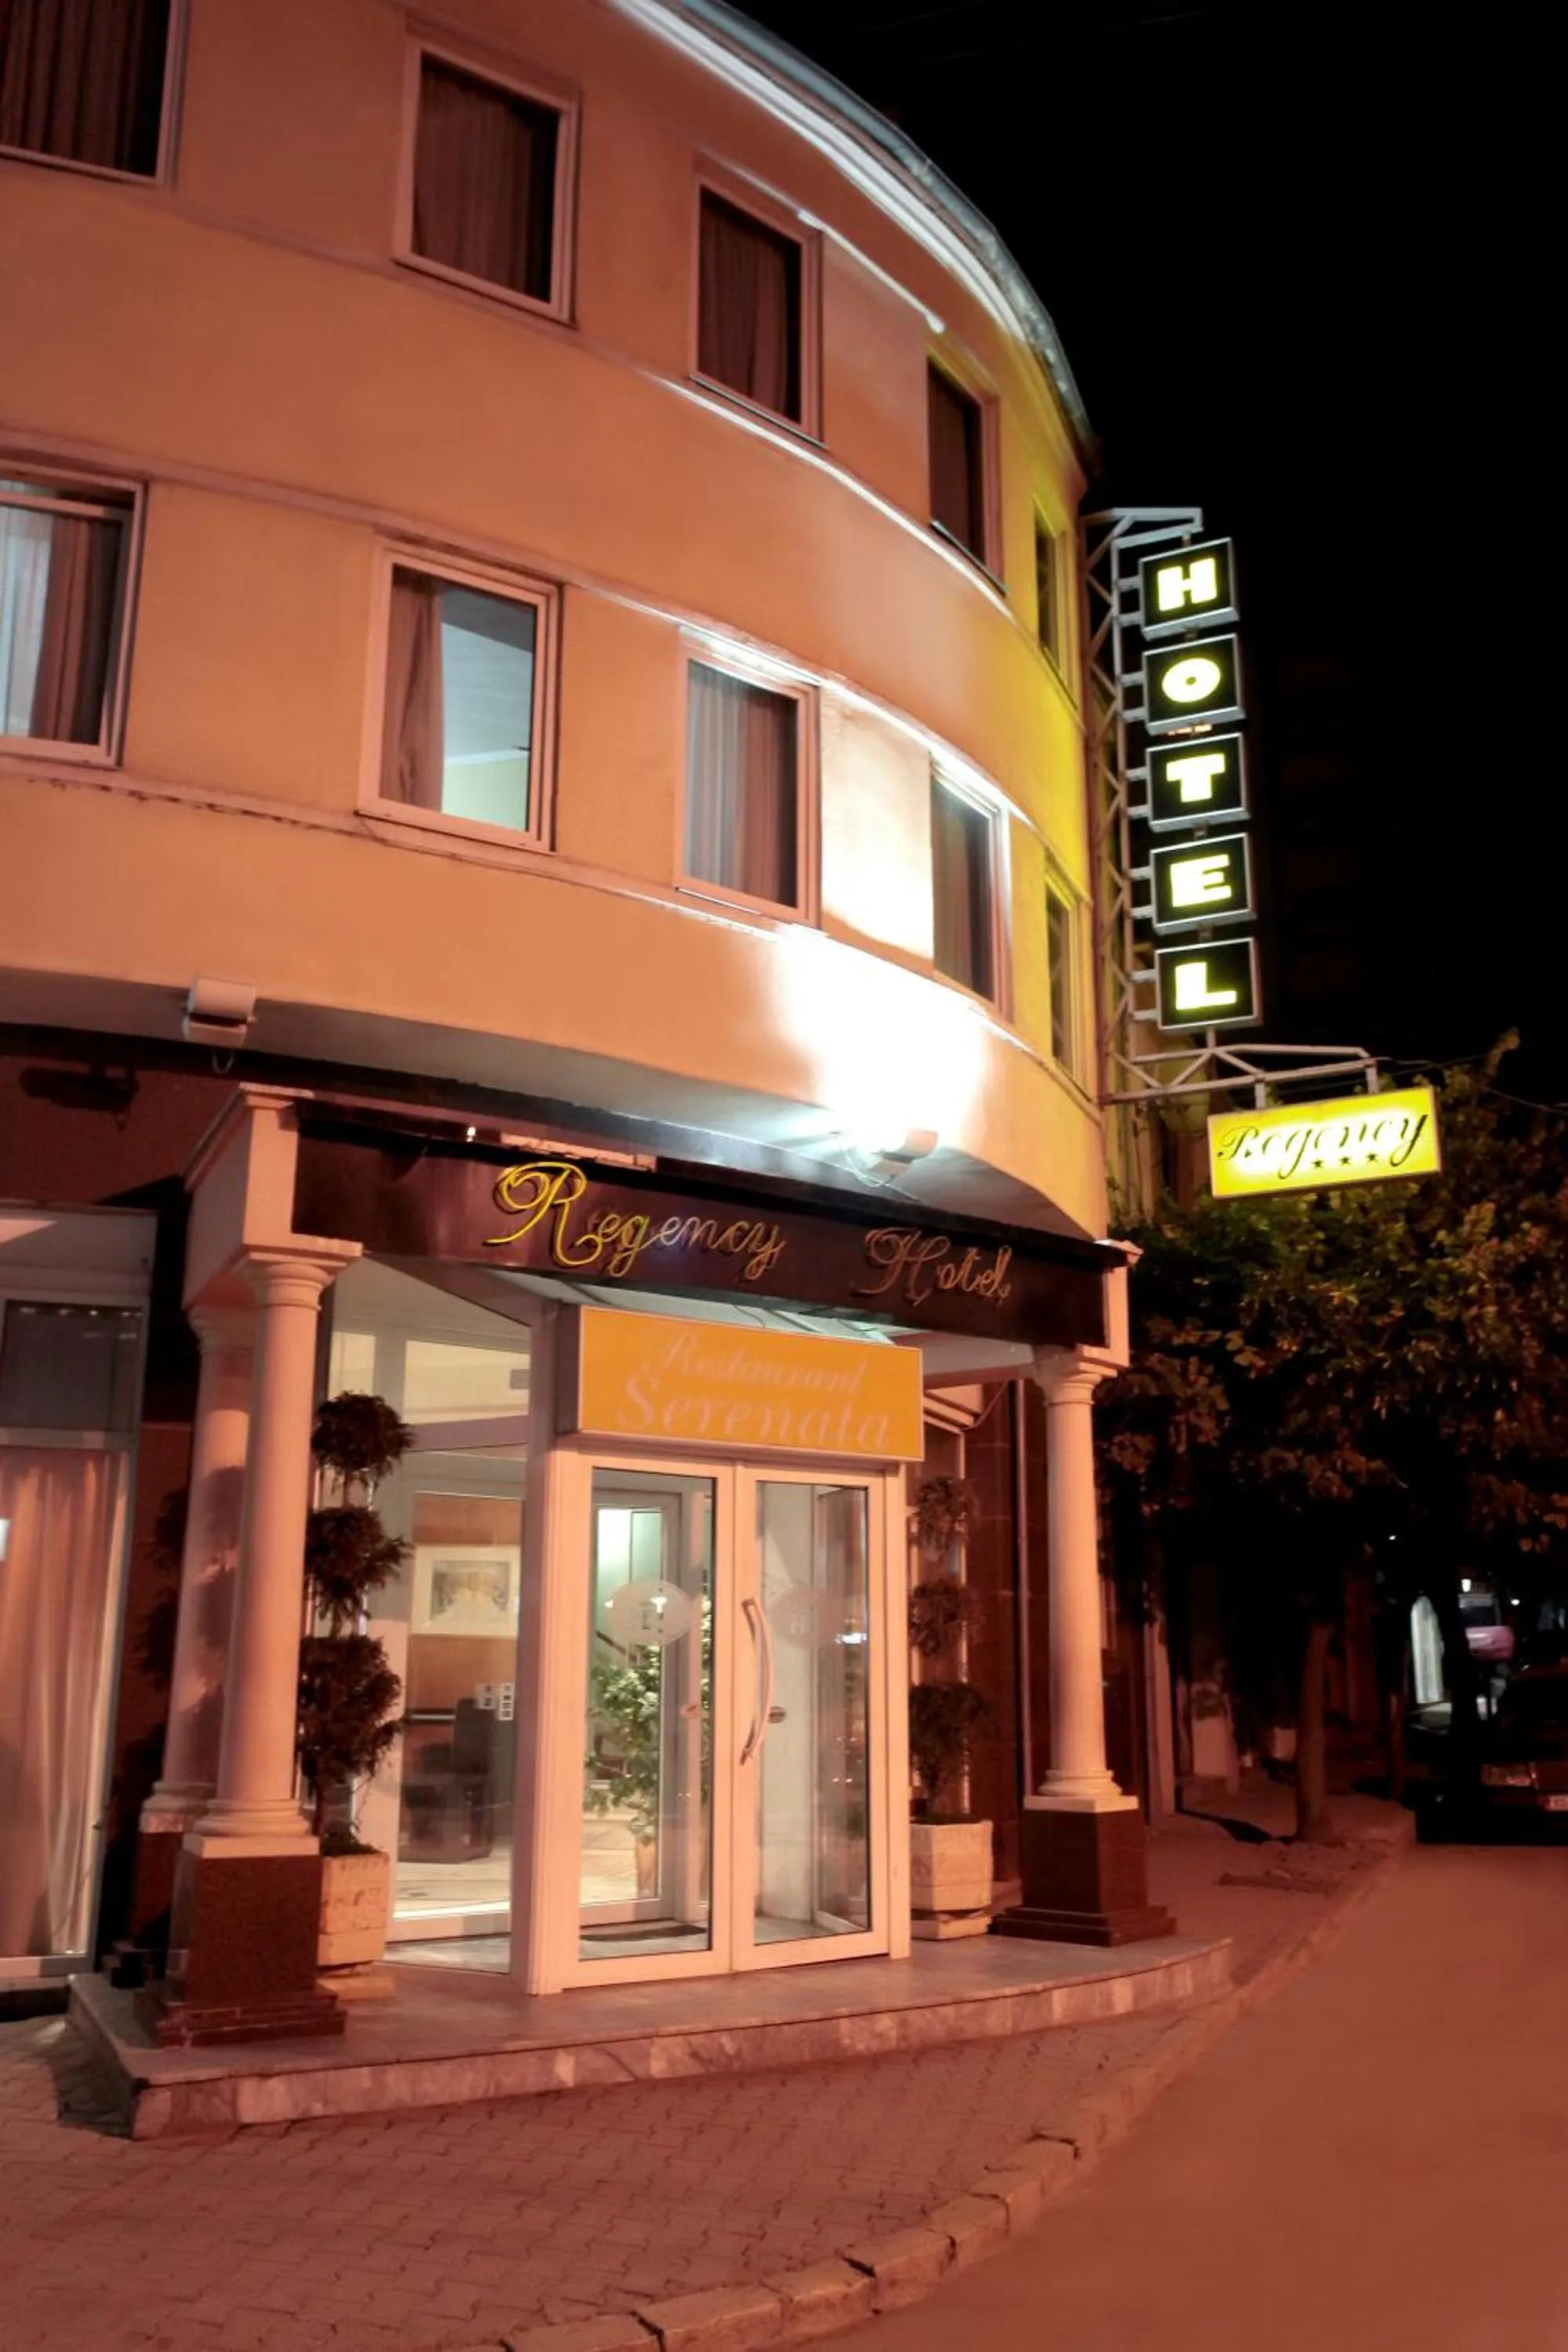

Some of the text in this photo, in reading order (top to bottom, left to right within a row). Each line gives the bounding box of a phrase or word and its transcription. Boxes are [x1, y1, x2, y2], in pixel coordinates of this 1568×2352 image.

[1157, 557, 1236, 1010] HOTEL
[1217, 1114, 1428, 1179] Regency
[484, 1162, 1013, 1306] Regency Hotel
[663, 1329, 868, 1393] Restaurant
[616, 1364, 891, 1449] Serenata
